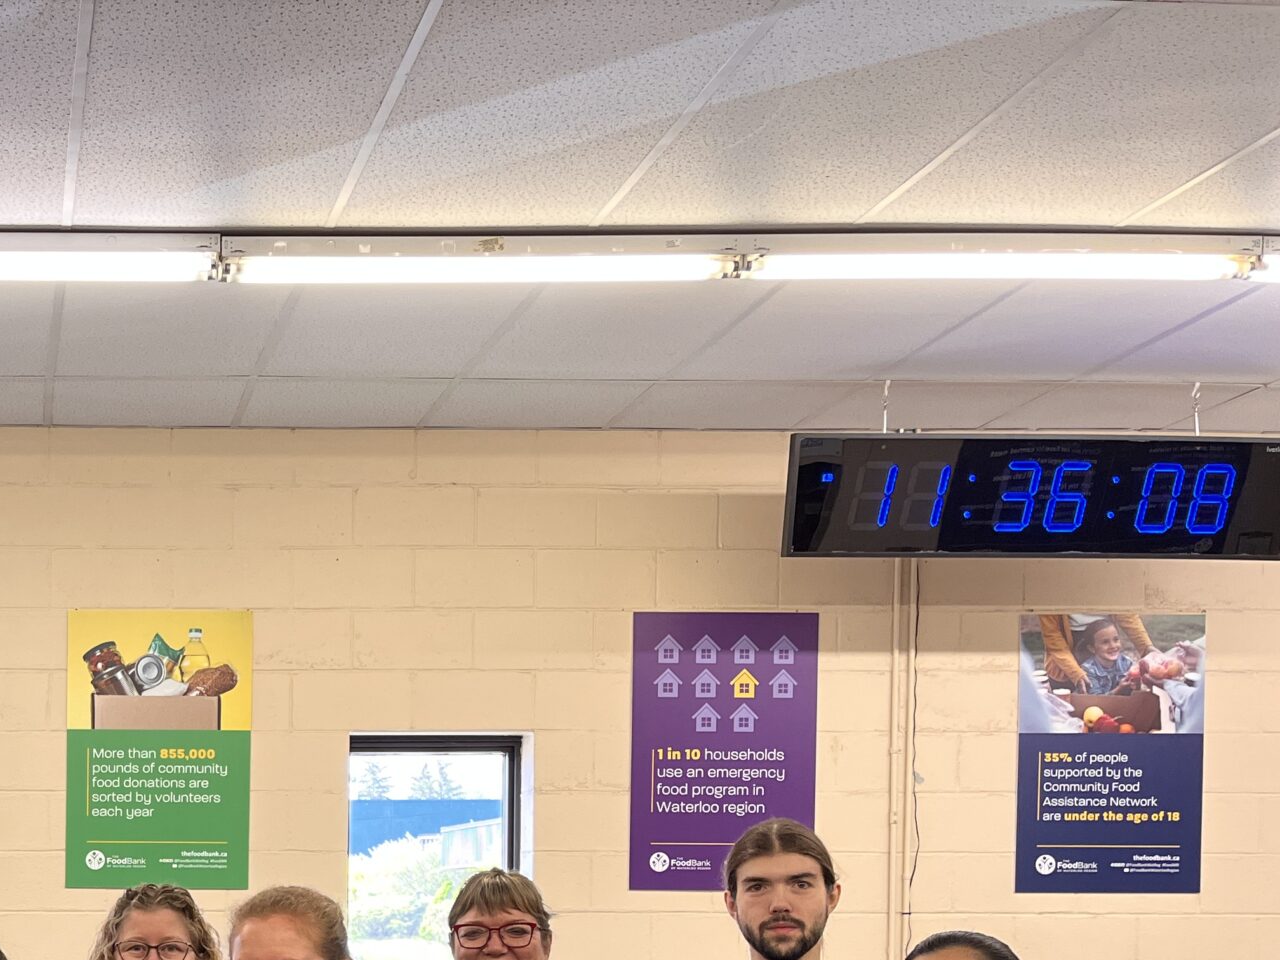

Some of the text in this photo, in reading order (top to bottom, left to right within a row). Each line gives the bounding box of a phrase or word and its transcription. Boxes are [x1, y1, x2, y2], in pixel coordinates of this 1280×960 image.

[92, 748, 216, 760] More than 855,000
[656, 747, 785, 761] 1 in 10 households
[1044, 752, 1128, 764] 35% of people
[92, 763, 228, 776] pounds of community
[657, 768, 786, 781] use an emergency
[1043, 767, 1143, 779] supported by the
[91, 777, 209, 788] food donations are
[1043, 782, 1140, 794] Community Food
[656, 783, 765, 798] food program in
[91, 791, 221, 805] sorted by volunteers
[1042, 796, 1158, 807] Assistance Network
[91, 806, 154, 820] each year
[656, 801, 766, 816] Waterloo region
[1042, 811, 1180, 824] are under the age of 18
[106, 857, 146, 865] FoodBank
[1057, 861, 1098, 869] FoodBank
